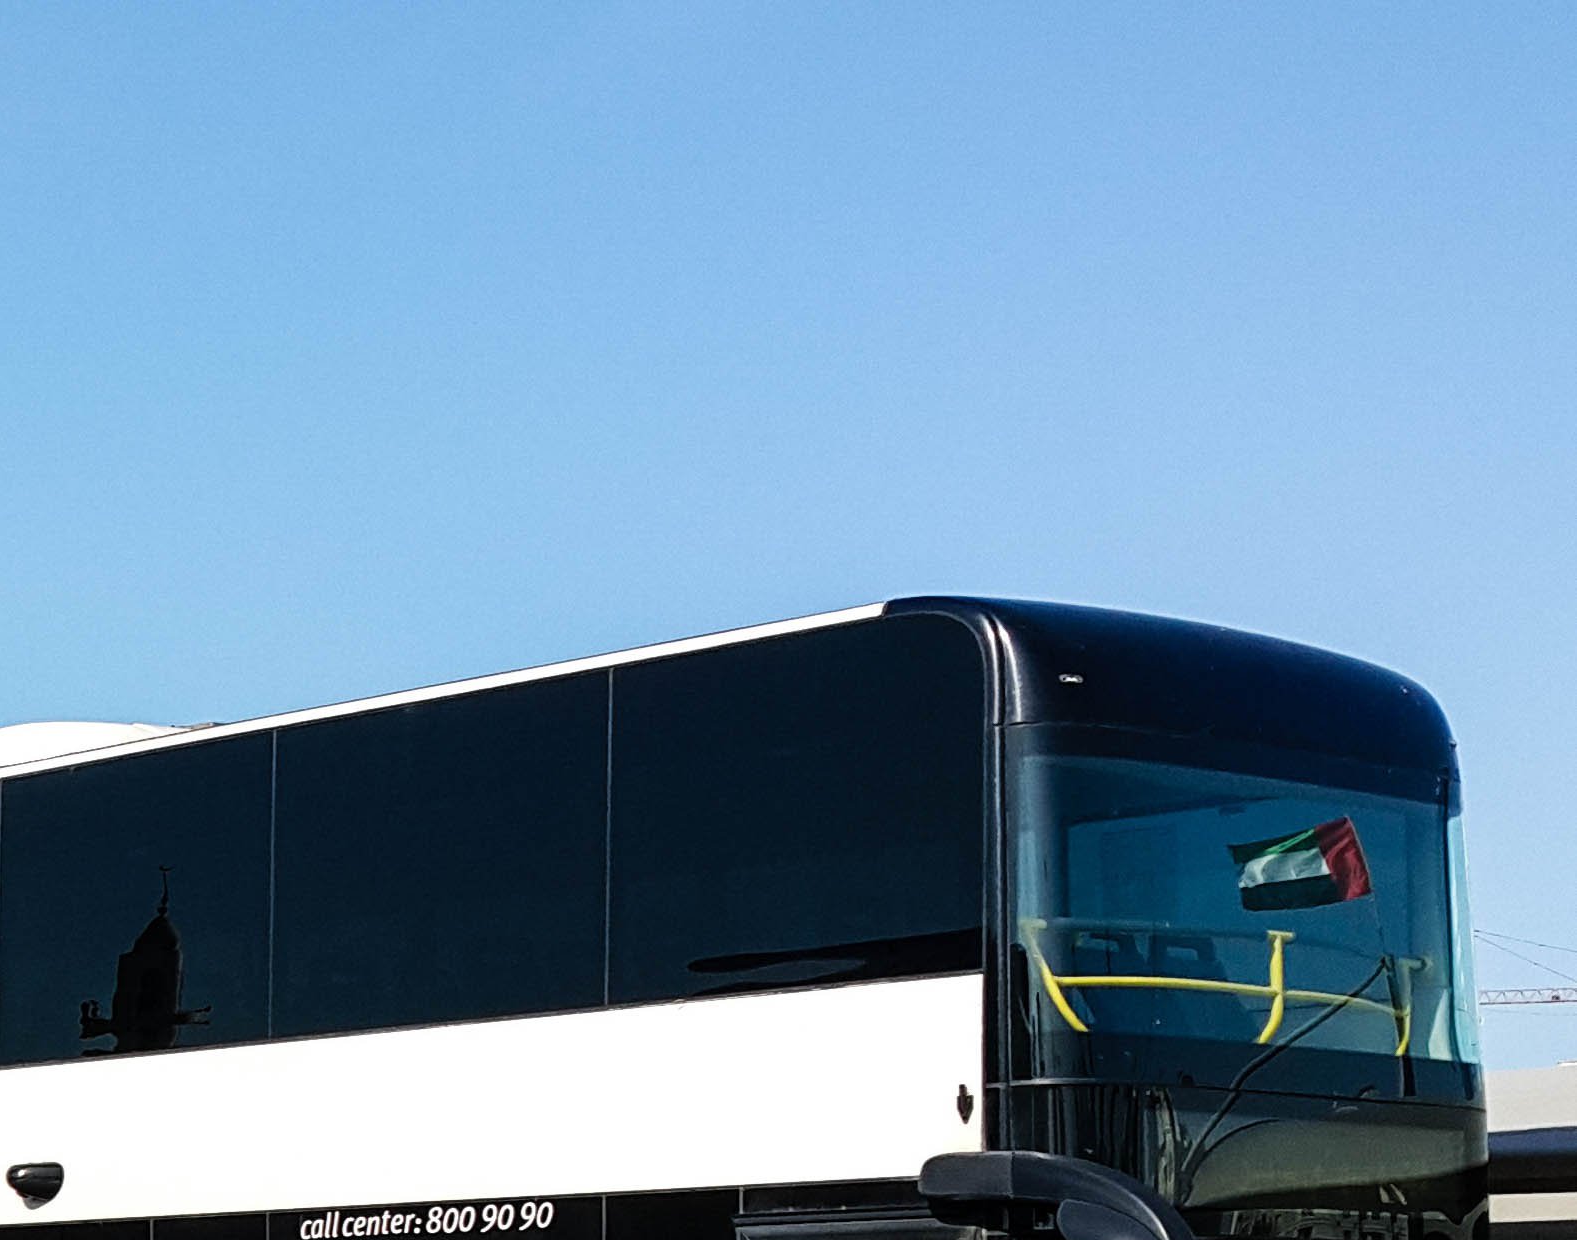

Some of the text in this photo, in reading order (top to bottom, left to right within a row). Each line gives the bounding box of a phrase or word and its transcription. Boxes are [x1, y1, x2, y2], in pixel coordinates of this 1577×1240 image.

[300, 1201, 554, 1240] call center: 800 90 90
